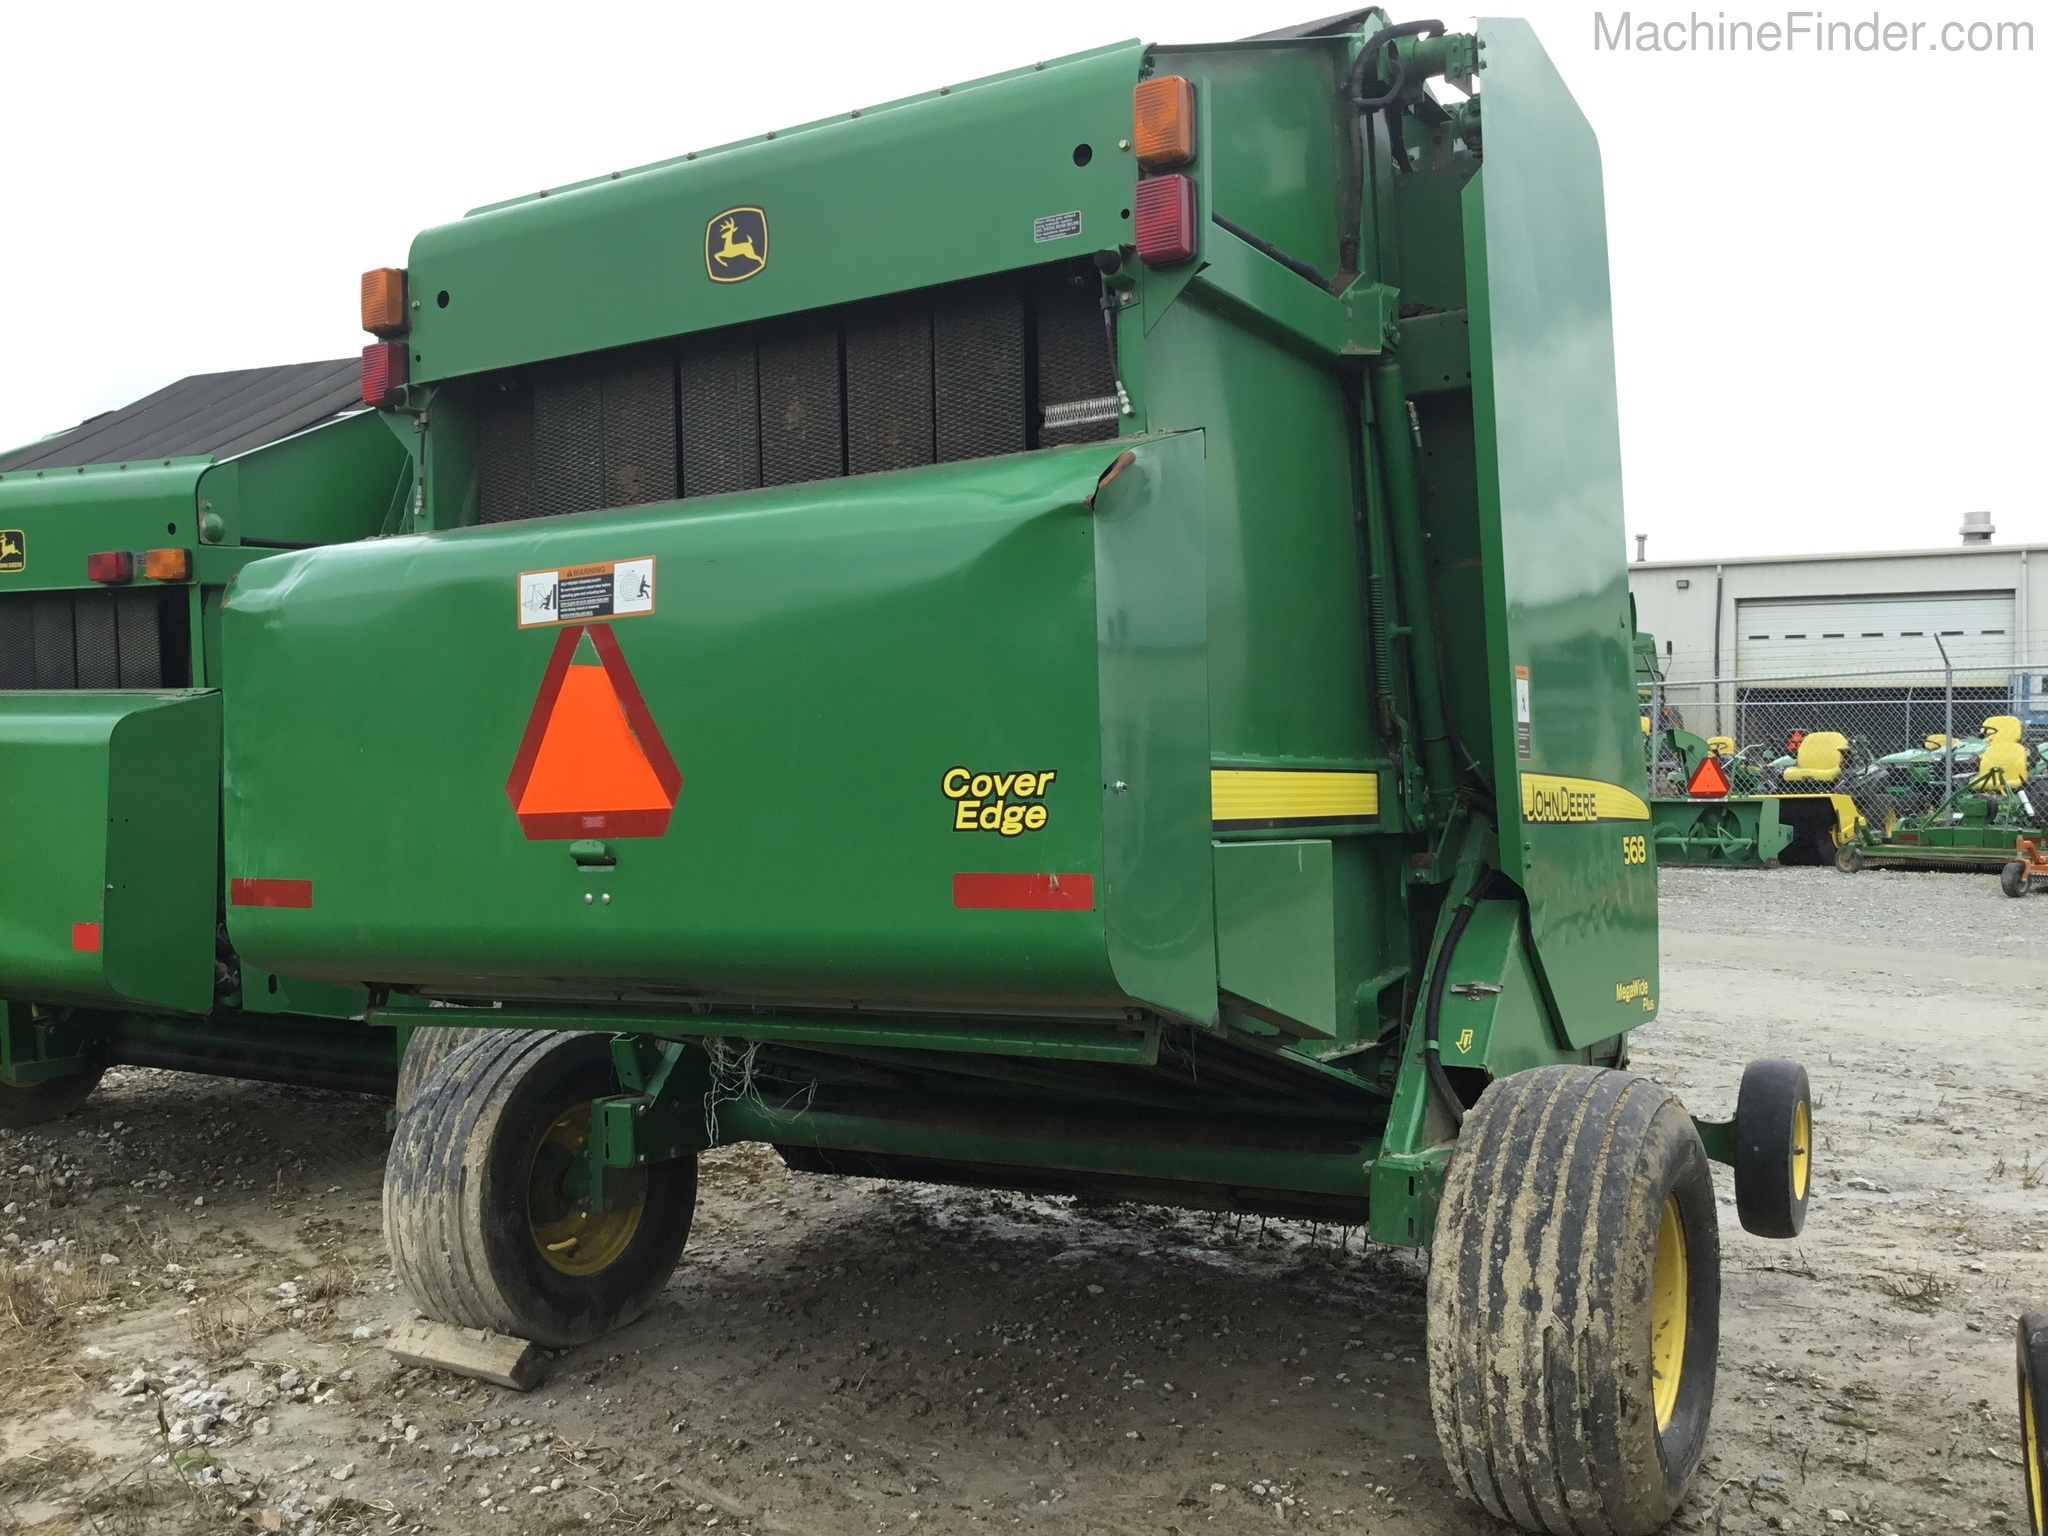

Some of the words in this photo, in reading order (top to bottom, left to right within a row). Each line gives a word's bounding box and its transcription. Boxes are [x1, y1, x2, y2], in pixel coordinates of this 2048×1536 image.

[572, 566, 606, 576] WARNING
[942, 767, 1056, 799] Cover
[954, 800, 1047, 836] Edge
[1622, 834, 1647, 866] 568
